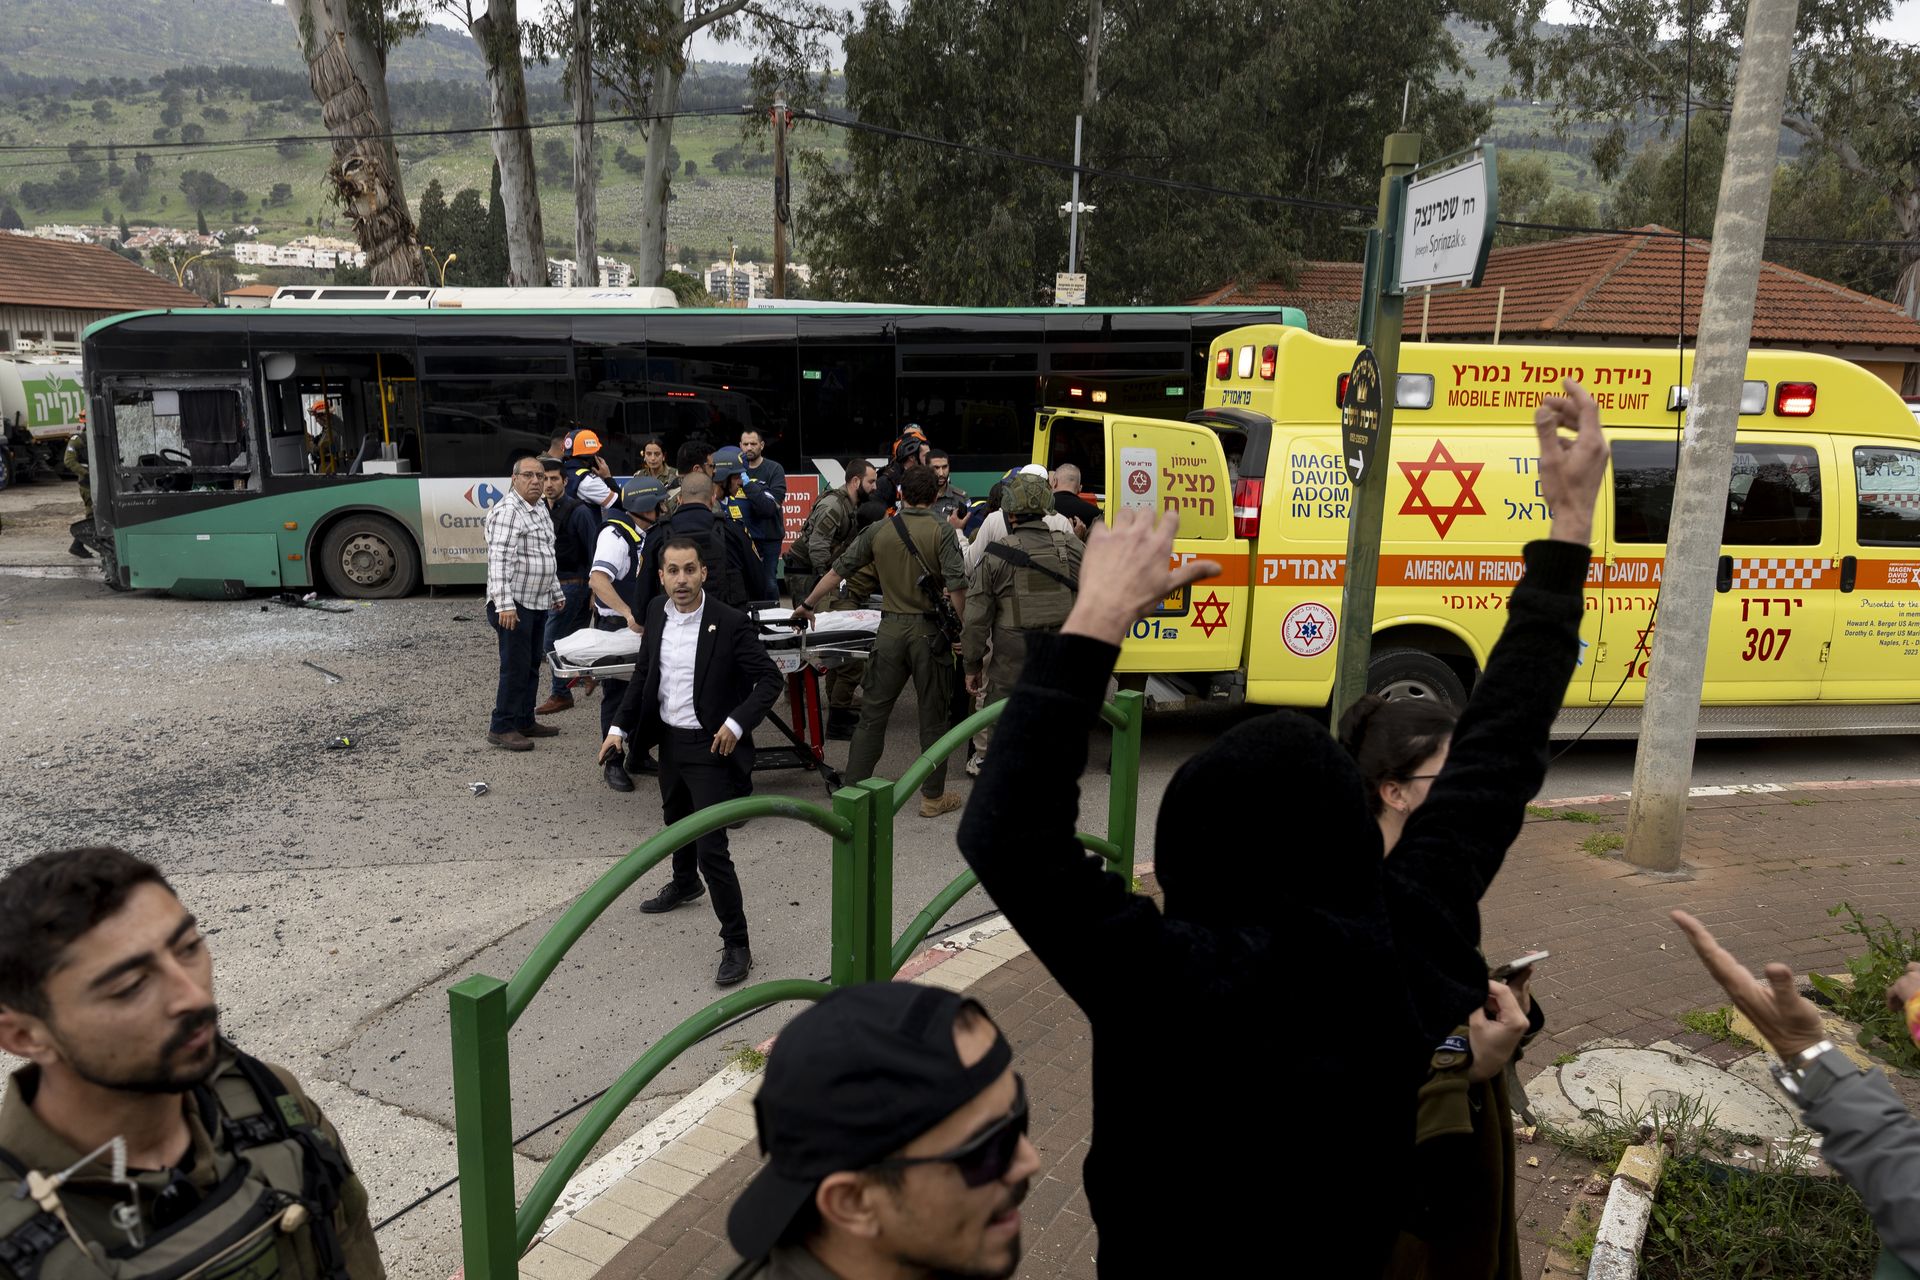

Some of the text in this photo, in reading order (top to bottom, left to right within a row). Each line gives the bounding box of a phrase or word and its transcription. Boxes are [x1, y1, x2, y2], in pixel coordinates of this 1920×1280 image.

[1413, 195, 1459, 236] שפרינצק
[1429, 229, 1460, 256] Sprinzak
[1452, 361, 1652, 386] ניידת טיפול נמרץ
[34, 391, 81, 425] נקייה
[1221, 390, 1252, 406] פראמדיק
[1448, 389, 1500, 407] MOBILE
[1504, 391, 1568, 408] INTEN
[1618, 393, 1649, 410] UNIT
[1171, 456, 1207, 468] יישומון
[1291, 454, 1344, 469] MAGE
[1162, 467, 1215, 493] מציל
[1292, 470, 1347, 485] DAVID
[1292, 487, 1349, 502] ADOM
[1163, 496, 1215, 517] חיים
[1291, 503, 1351, 519] IN ISR
[1504, 498, 1555, 520] ראל
[440, 513, 487, 528] Carre
[1263, 559, 1346, 584] אמדיק
[1404, 559, 1474, 581] AMERICAN
[1609, 562, 1649, 582] DAVID
[1741, 598, 1803, 622] ירדן
[1860, 598, 1895, 608] Presented
[1876, 630, 1896, 638] Berger
[1877, 620, 1897, 628] Berger
[1907, 620, 1920, 628] Arm
[1742, 628, 1792, 662] 307
